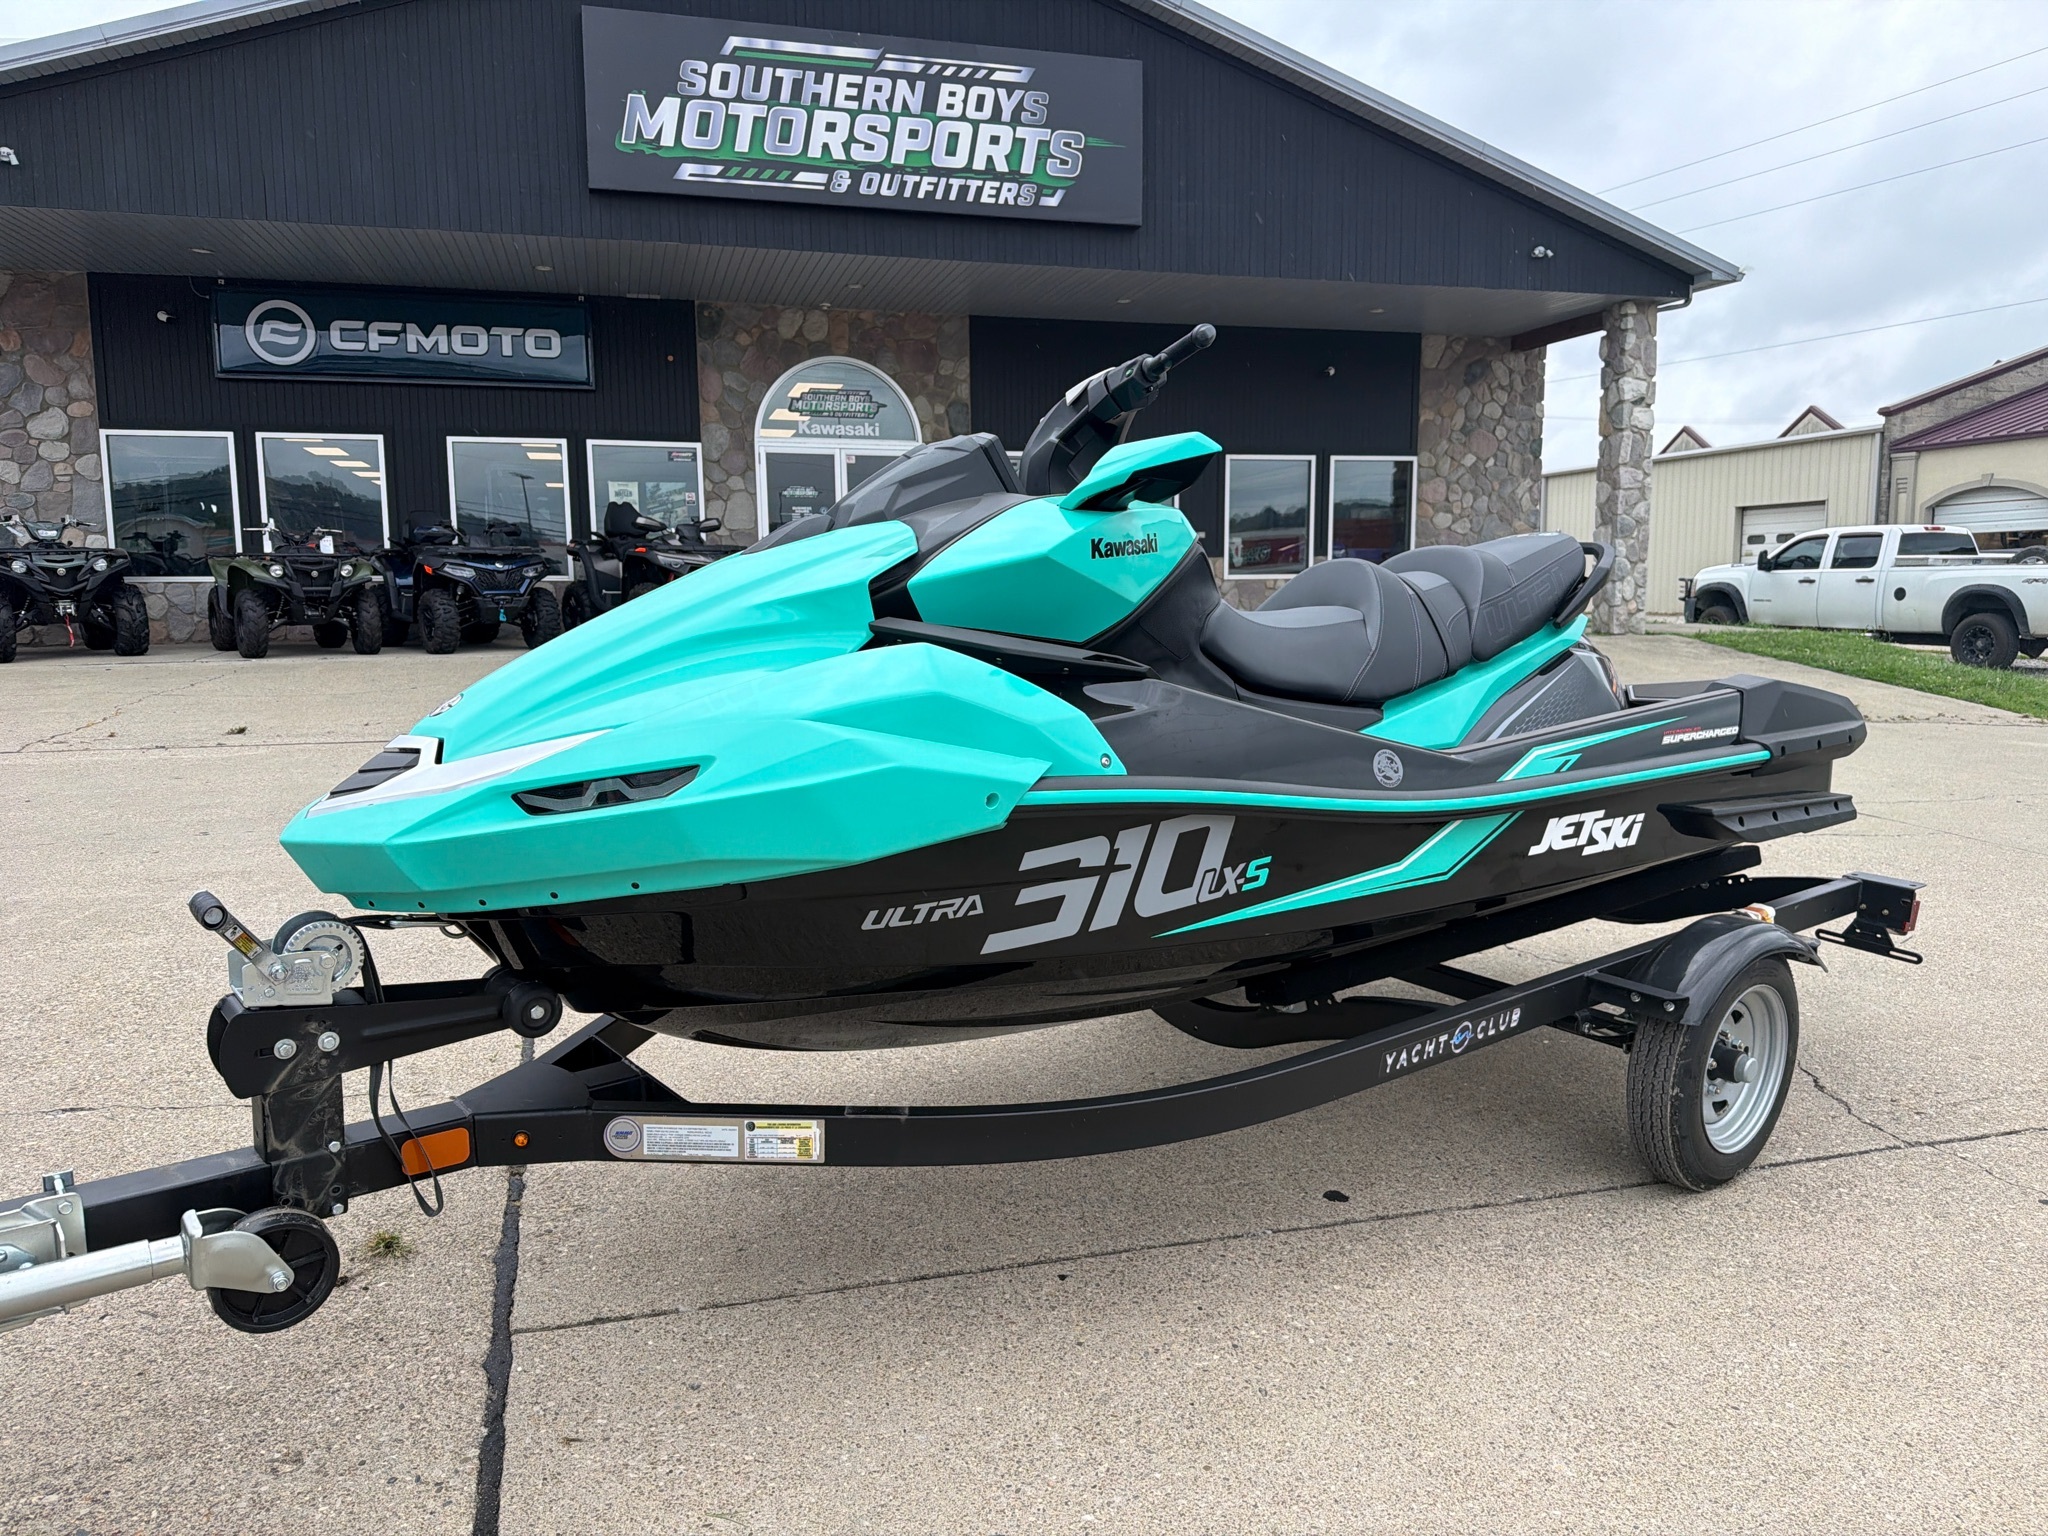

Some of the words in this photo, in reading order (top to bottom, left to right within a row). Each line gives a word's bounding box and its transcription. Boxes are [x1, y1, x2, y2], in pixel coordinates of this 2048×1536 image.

[677, 59, 926, 115] SOUTHERN
[935, 82, 1050, 126] BOYS
[620, 92, 1086, 178] MOTORSPORTS
[829, 169, 852, 194] &
[858, 171, 1038, 207] OUTFITTERS
[329, 319, 562, 359] CFMOTO
[791, 400, 878, 412] MOTORSPORTS
[801, 393, 847, 402] SOUTHERN
[848, 395, 871, 403] BOYS
[798, 420, 880, 437] Kawasaki
[1090, 532, 1159, 560] Kawasaki
[1661, 725, 1740, 745] SUPERCHARGED
[860, 894, 984, 931] ULTRA
[980, 814, 1236, 955] 310
[1197, 855, 1273, 903] LX-S
[1385, 1033, 1449, 1073] YACHT
[1476, 1007, 1522, 1040] CLUB
